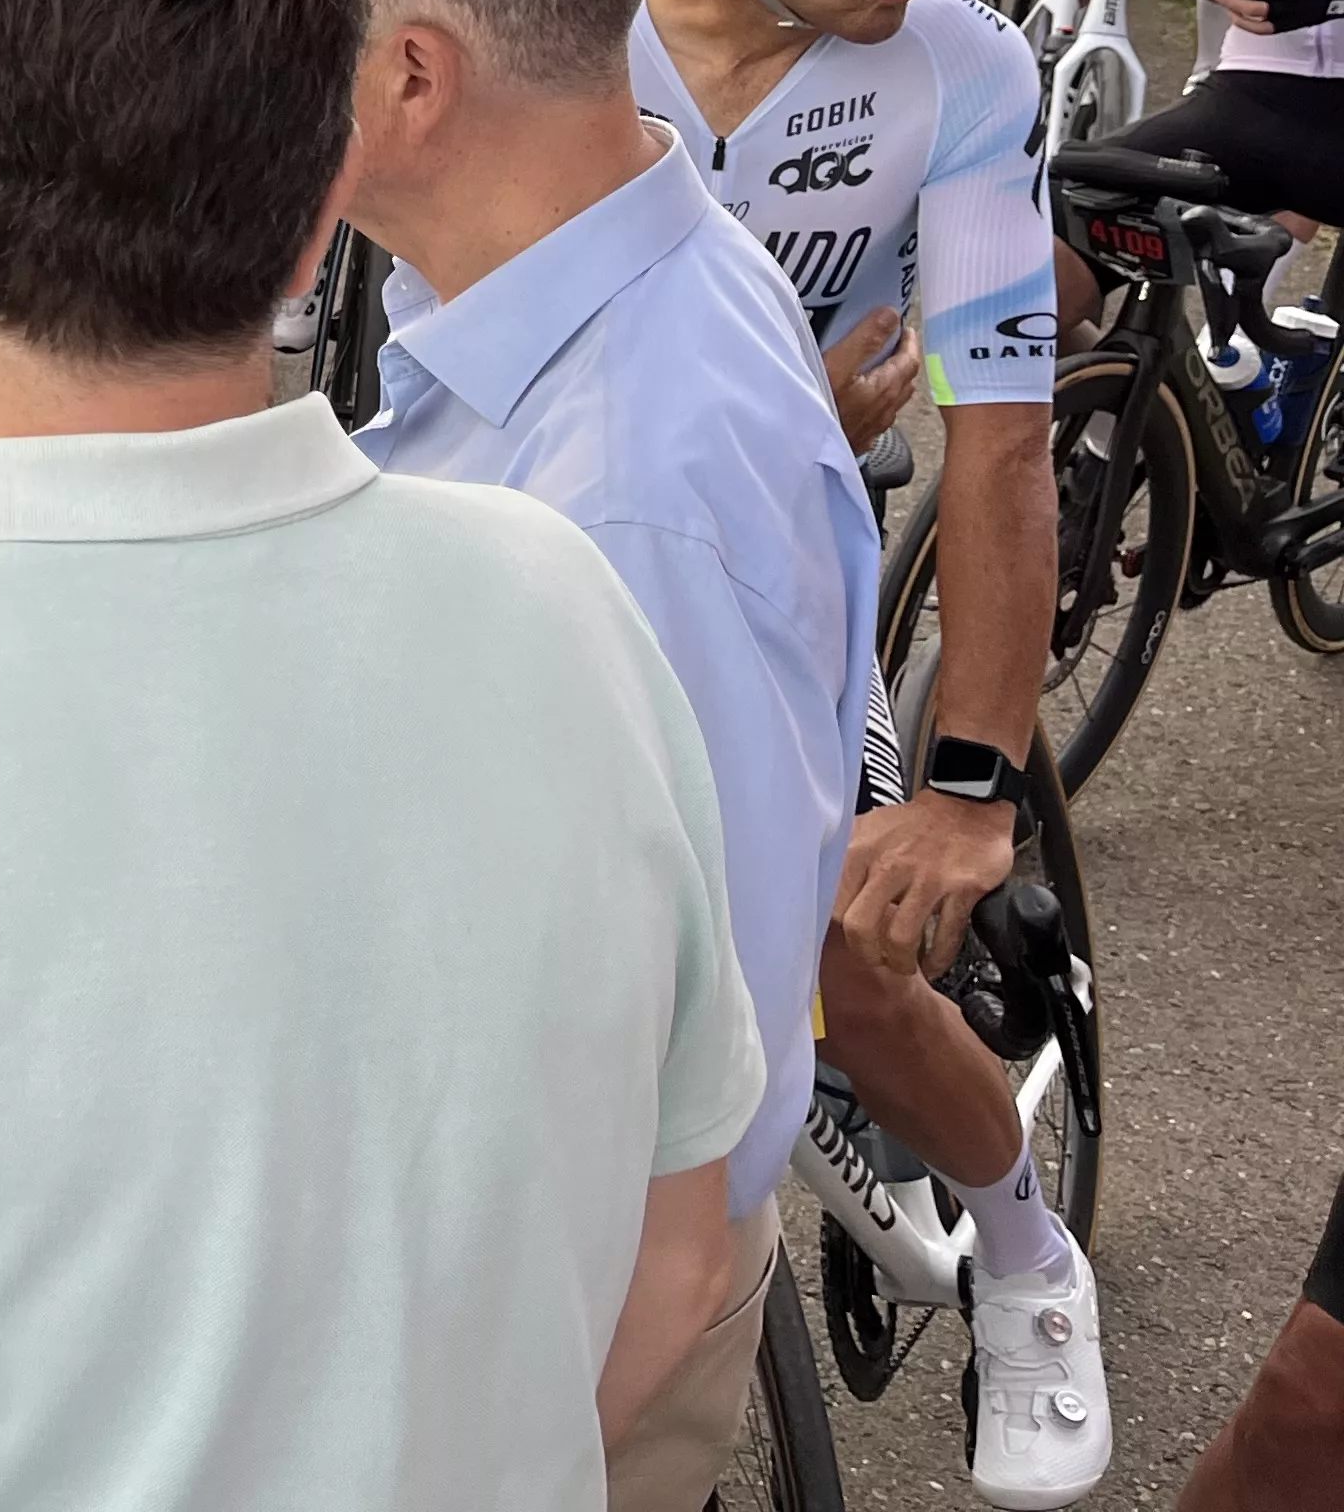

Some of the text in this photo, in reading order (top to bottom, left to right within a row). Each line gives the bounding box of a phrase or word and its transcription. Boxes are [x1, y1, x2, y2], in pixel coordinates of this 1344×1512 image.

[785, 90, 877, 138] GOBIK
[814, 133, 874, 154] servicios
[1091, 218, 1165, 261] 4109
[970, 344, 1056, 360] OAKL
[1185, 347, 1257, 516] ORBEA
[808, 1094, 897, 1231] ORKS
